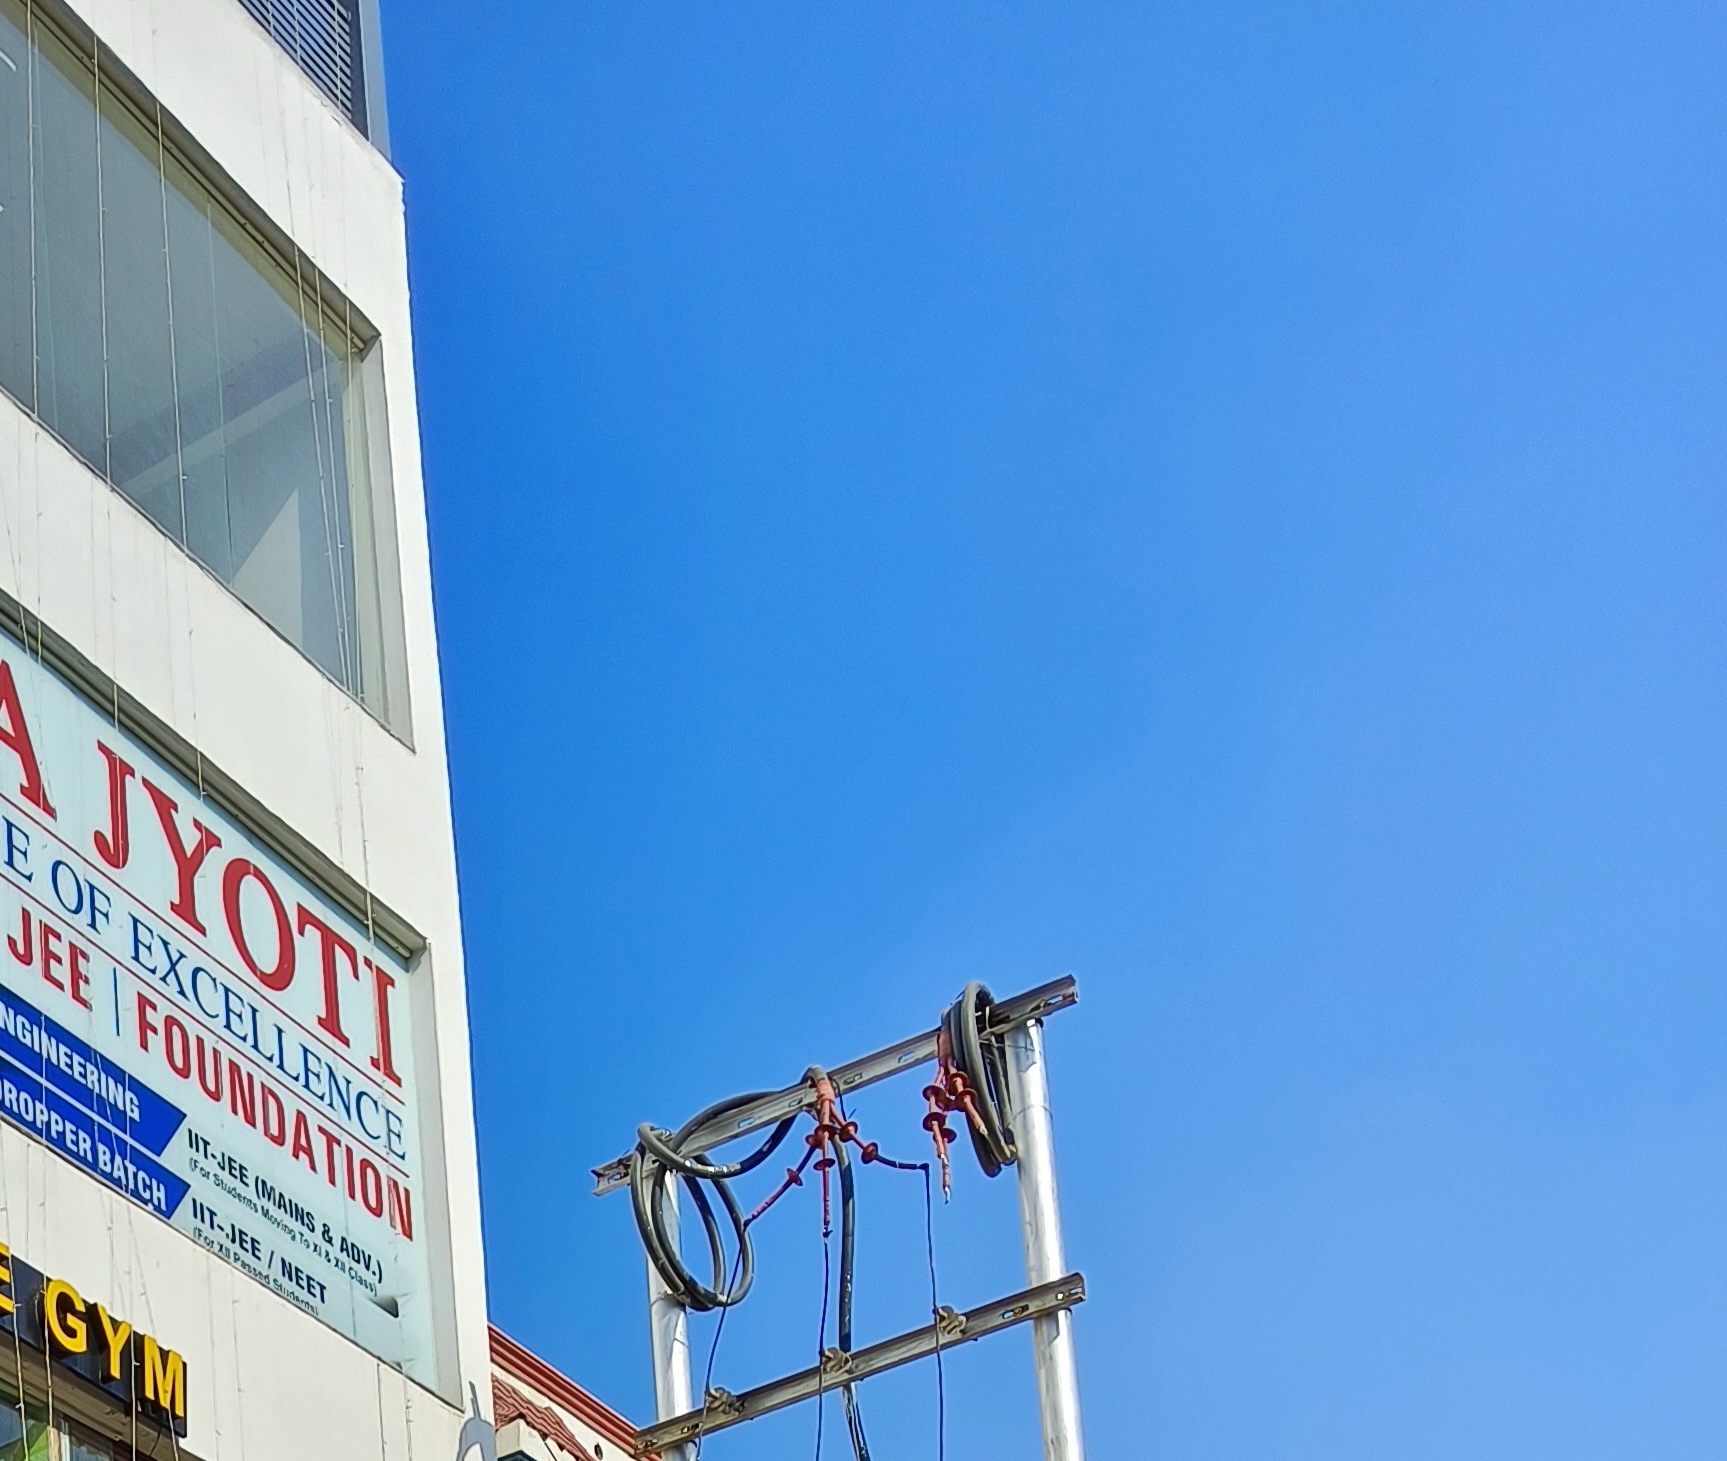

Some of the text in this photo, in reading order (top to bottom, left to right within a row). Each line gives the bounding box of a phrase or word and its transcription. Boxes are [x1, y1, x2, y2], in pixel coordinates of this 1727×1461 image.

[50, 858, 114, 935] OF
[130, 913, 406, 1163] EXCELLENCE
[94, 737, 404, 1089] JYOTI
[7, 907, 94, 1013] JEE
[135, 991, 413, 1243] FOUNDATION
[97, 1142, 168, 1213] BATCH
[187, 1128, 383, 1285] IIT-JEE (MAINS & ADV.)
[47, 1281, 185, 1419] GYM
